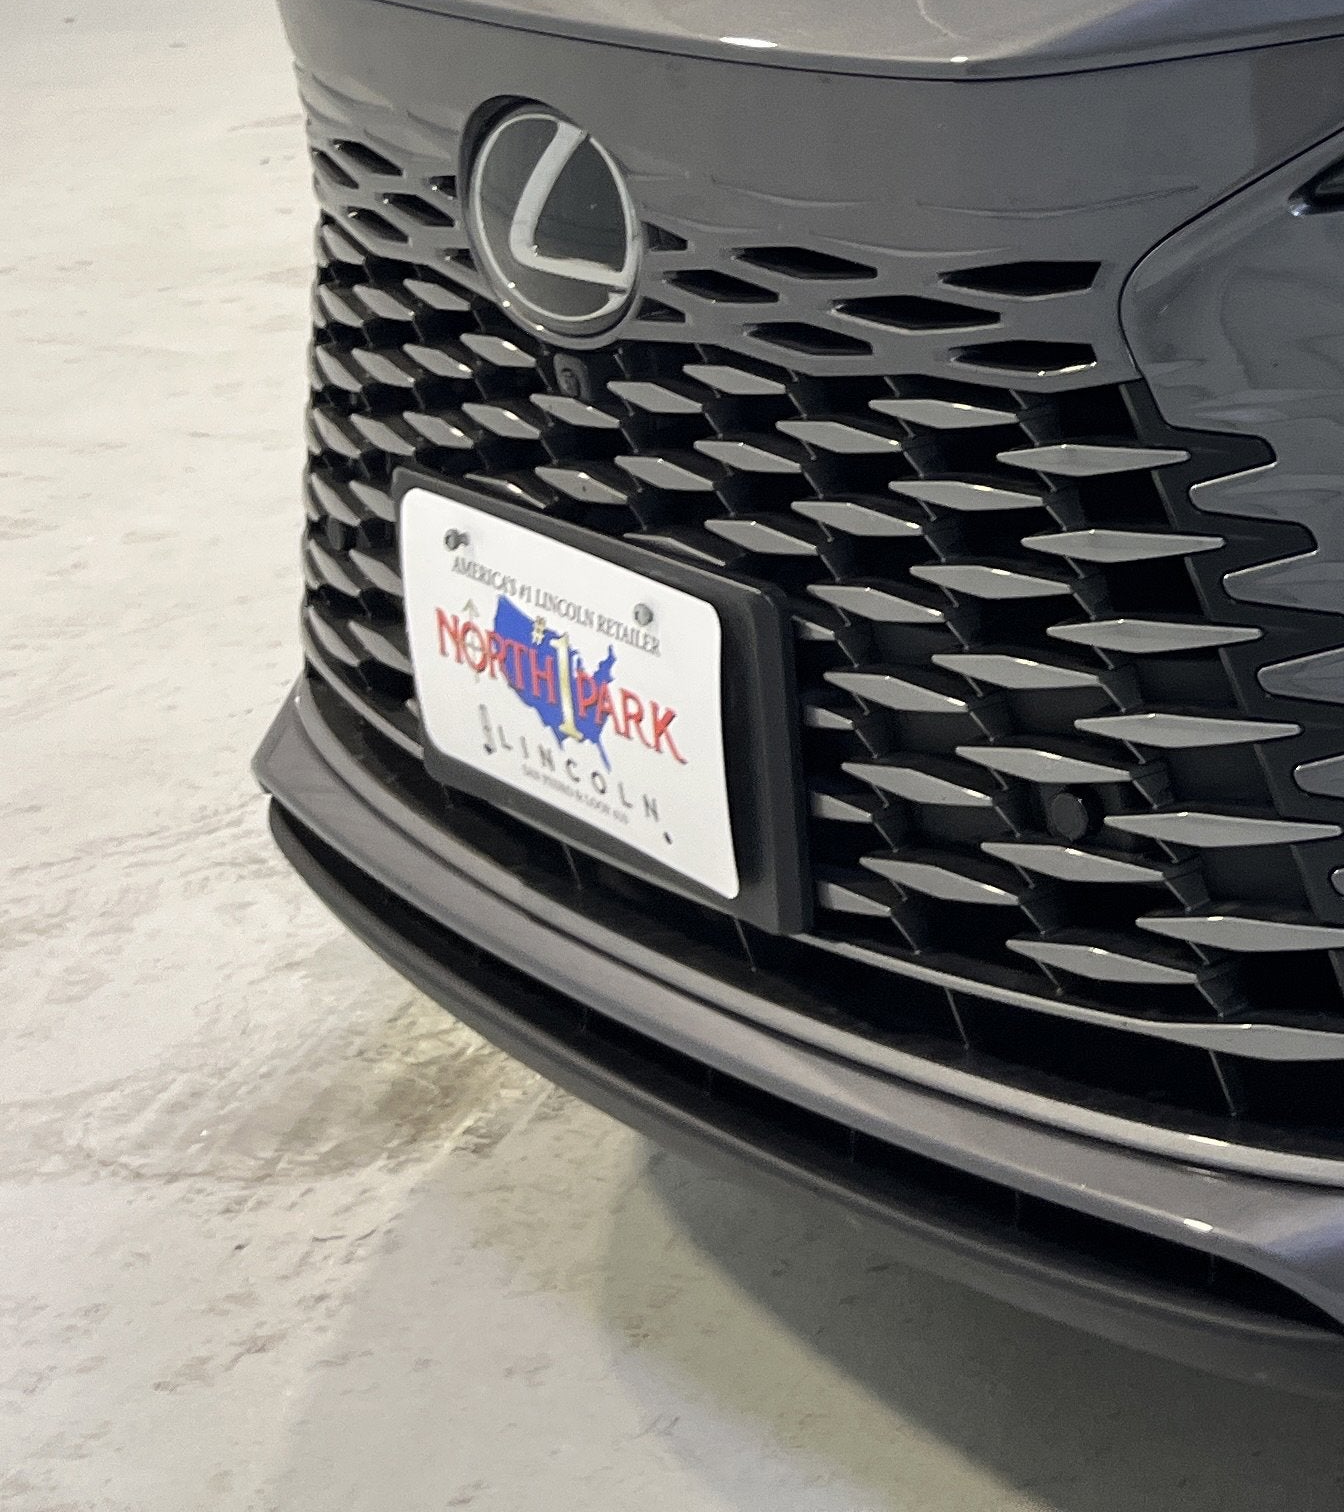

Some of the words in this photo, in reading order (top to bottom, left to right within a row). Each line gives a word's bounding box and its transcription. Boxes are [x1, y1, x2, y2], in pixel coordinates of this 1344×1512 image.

[534, 588, 595, 629] LINCOLN
[596, 613, 661, 656] RETAILER
[435, 606, 557, 705] NORTH
[575, 668, 688, 765] PARK
[499, 725, 660, 822] LINCOLN
